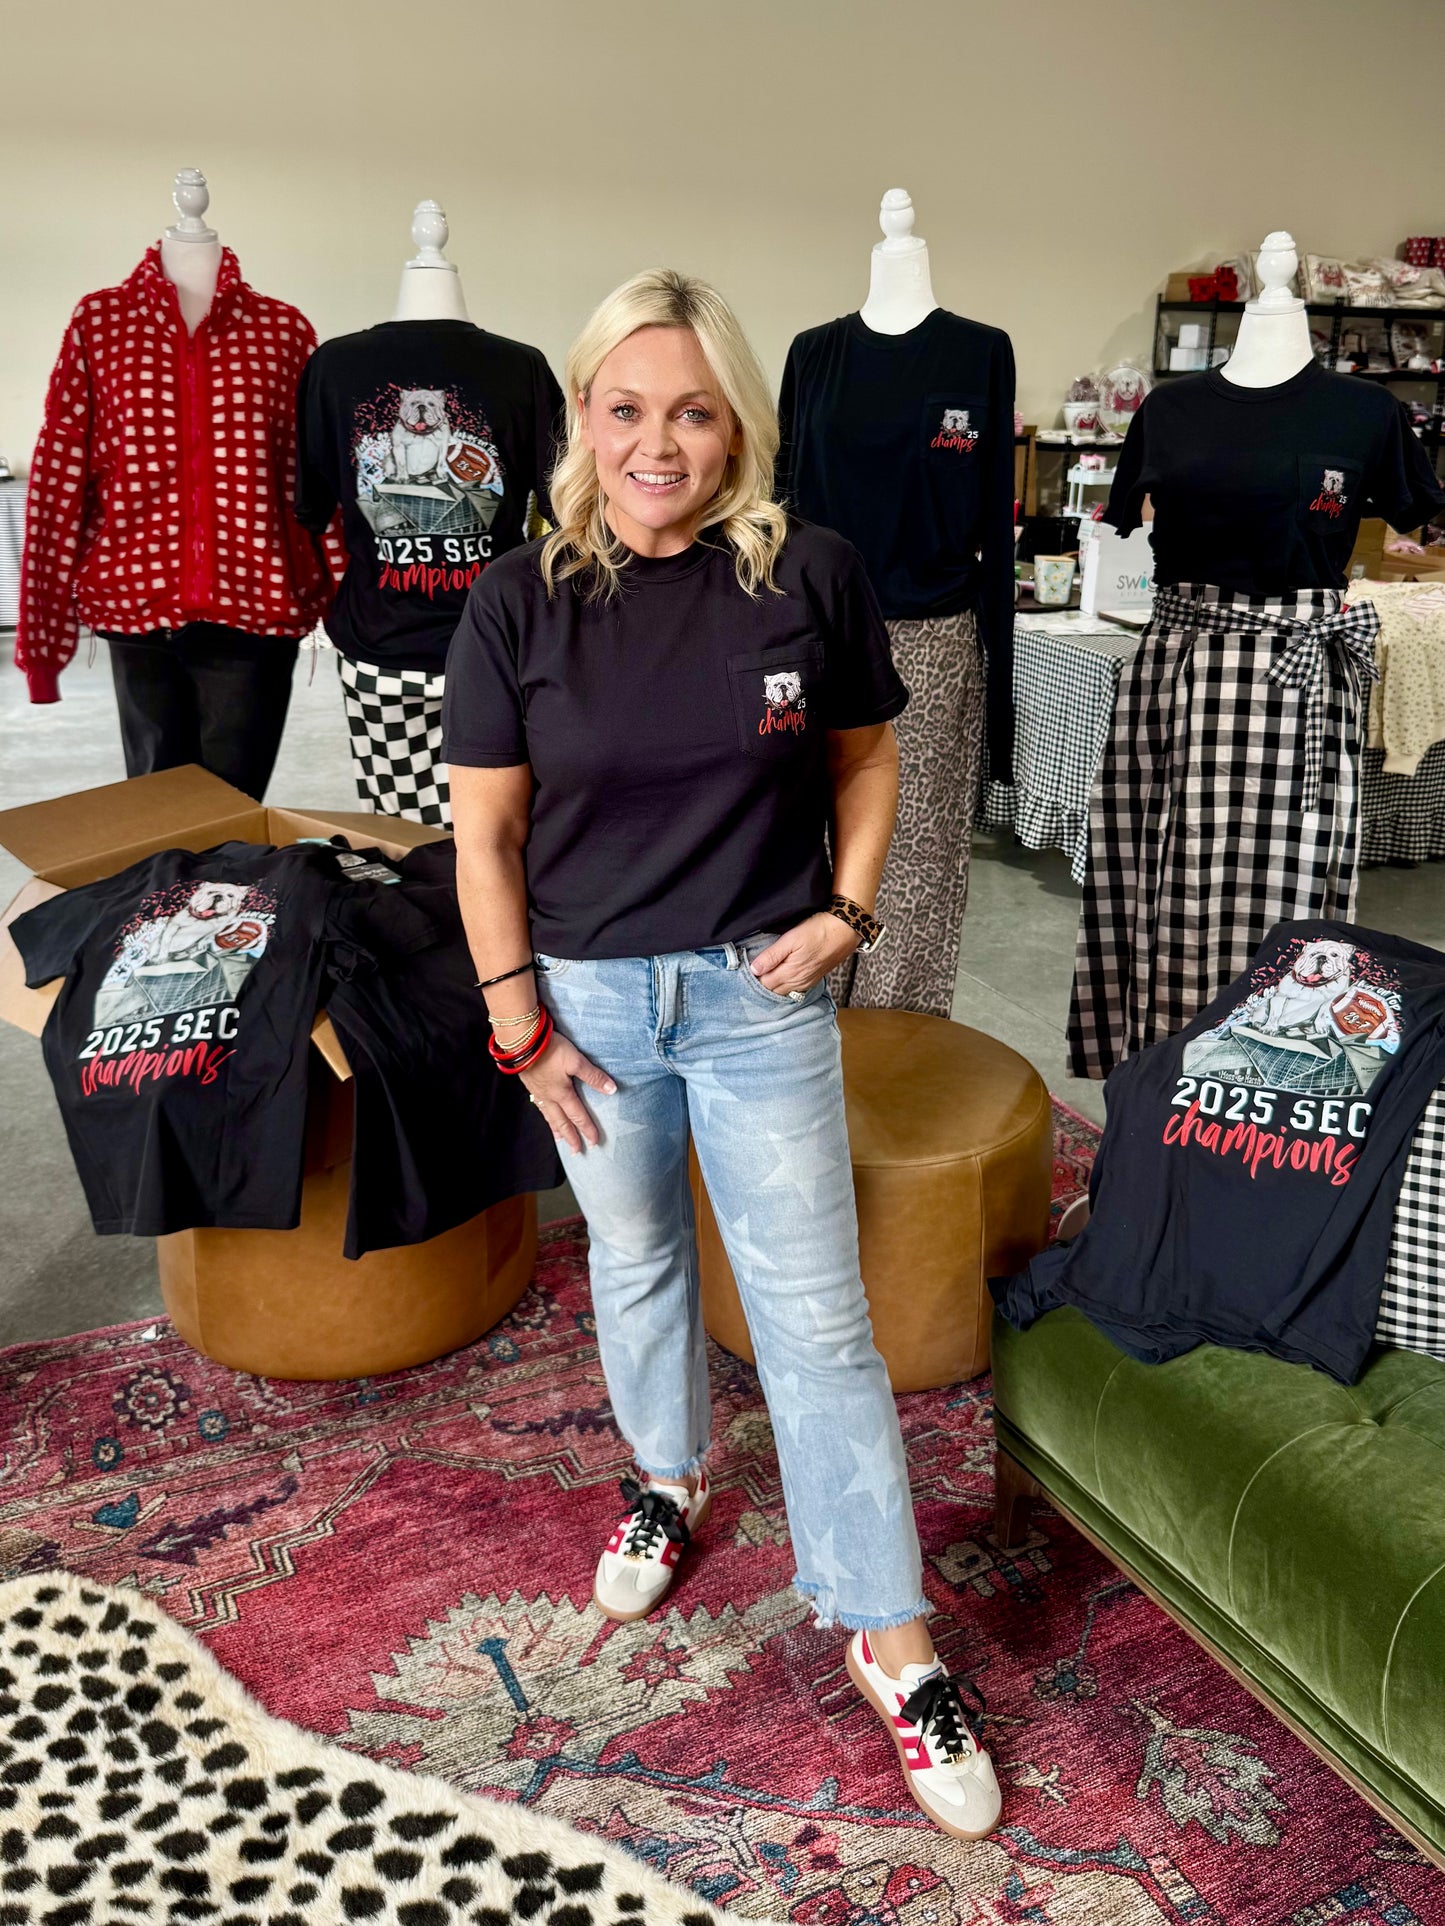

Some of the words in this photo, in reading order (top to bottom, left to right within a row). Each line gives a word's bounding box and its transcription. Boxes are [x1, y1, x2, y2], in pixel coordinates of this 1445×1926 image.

[930, 431, 977, 455] champs
[966, 430, 979, 439] 25
[443, 535, 493, 563] SEC
[797, 698, 806, 710] 25
[758, 707, 808, 736] champs
[78, 1018, 165, 1059] 2025
[171, 1007, 241, 1045] SEC
[81, 1040, 238, 1097] champions
[1170, 1076, 1278, 1125] 2025
[1289, 1099, 1373, 1139] SEC
[1162, 1099, 1362, 1186] champions
